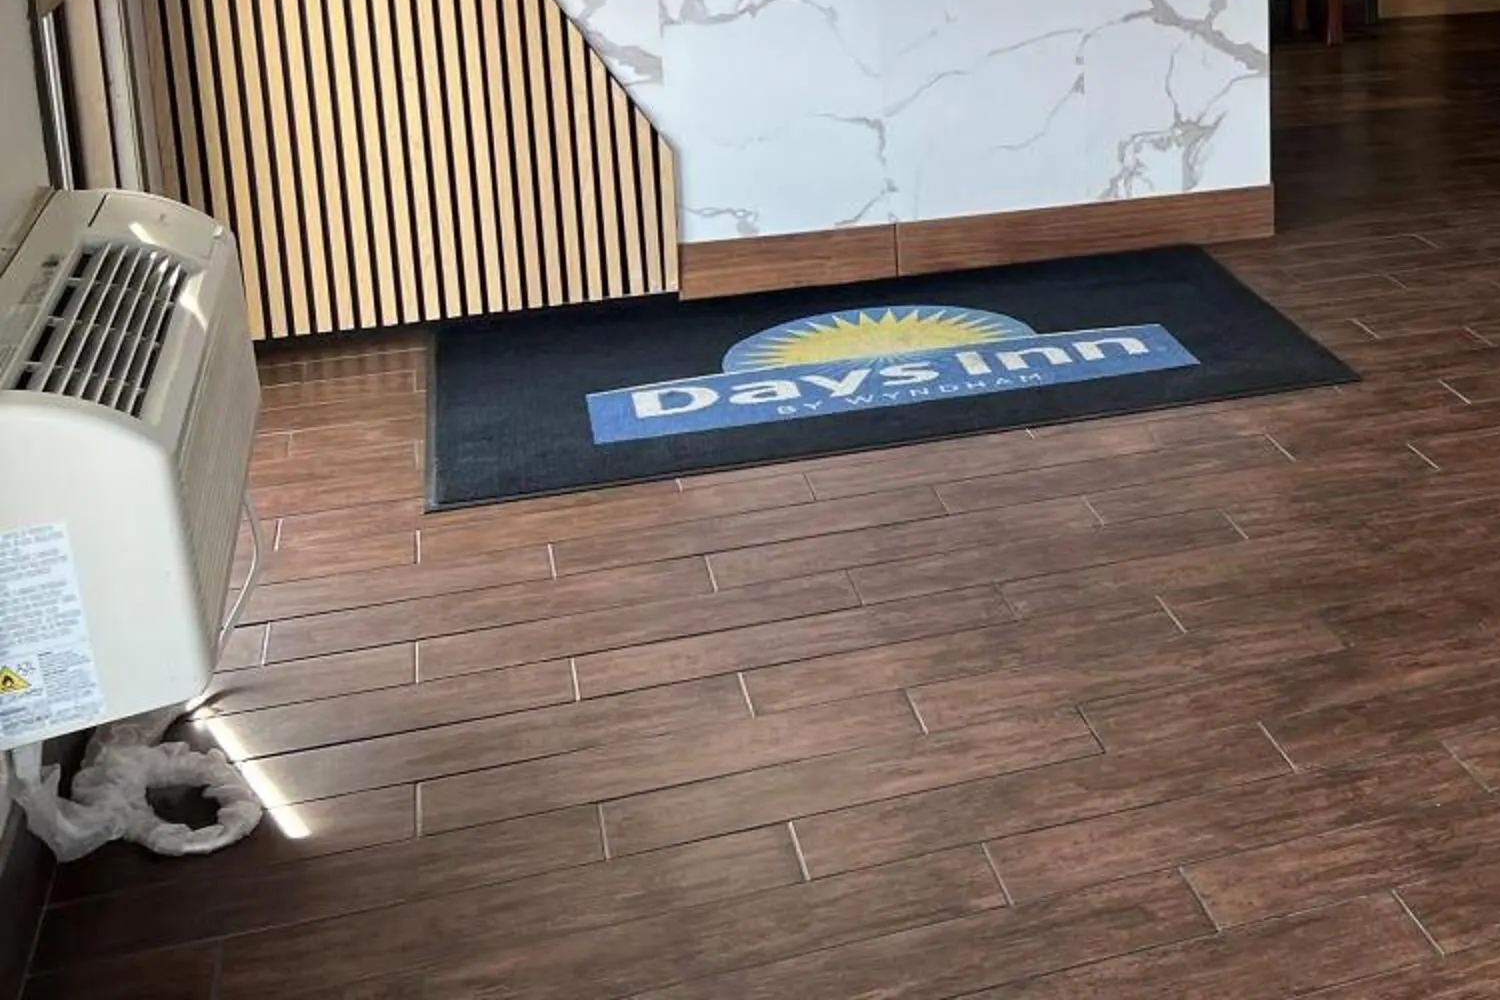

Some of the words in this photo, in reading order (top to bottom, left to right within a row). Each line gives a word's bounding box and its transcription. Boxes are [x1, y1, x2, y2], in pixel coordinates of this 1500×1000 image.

[631, 361, 940, 419] Days
[954, 337, 1150, 377] Inn
[777, 399, 824, 415] BY
[845, 372, 1043, 406] WYNDHAM
